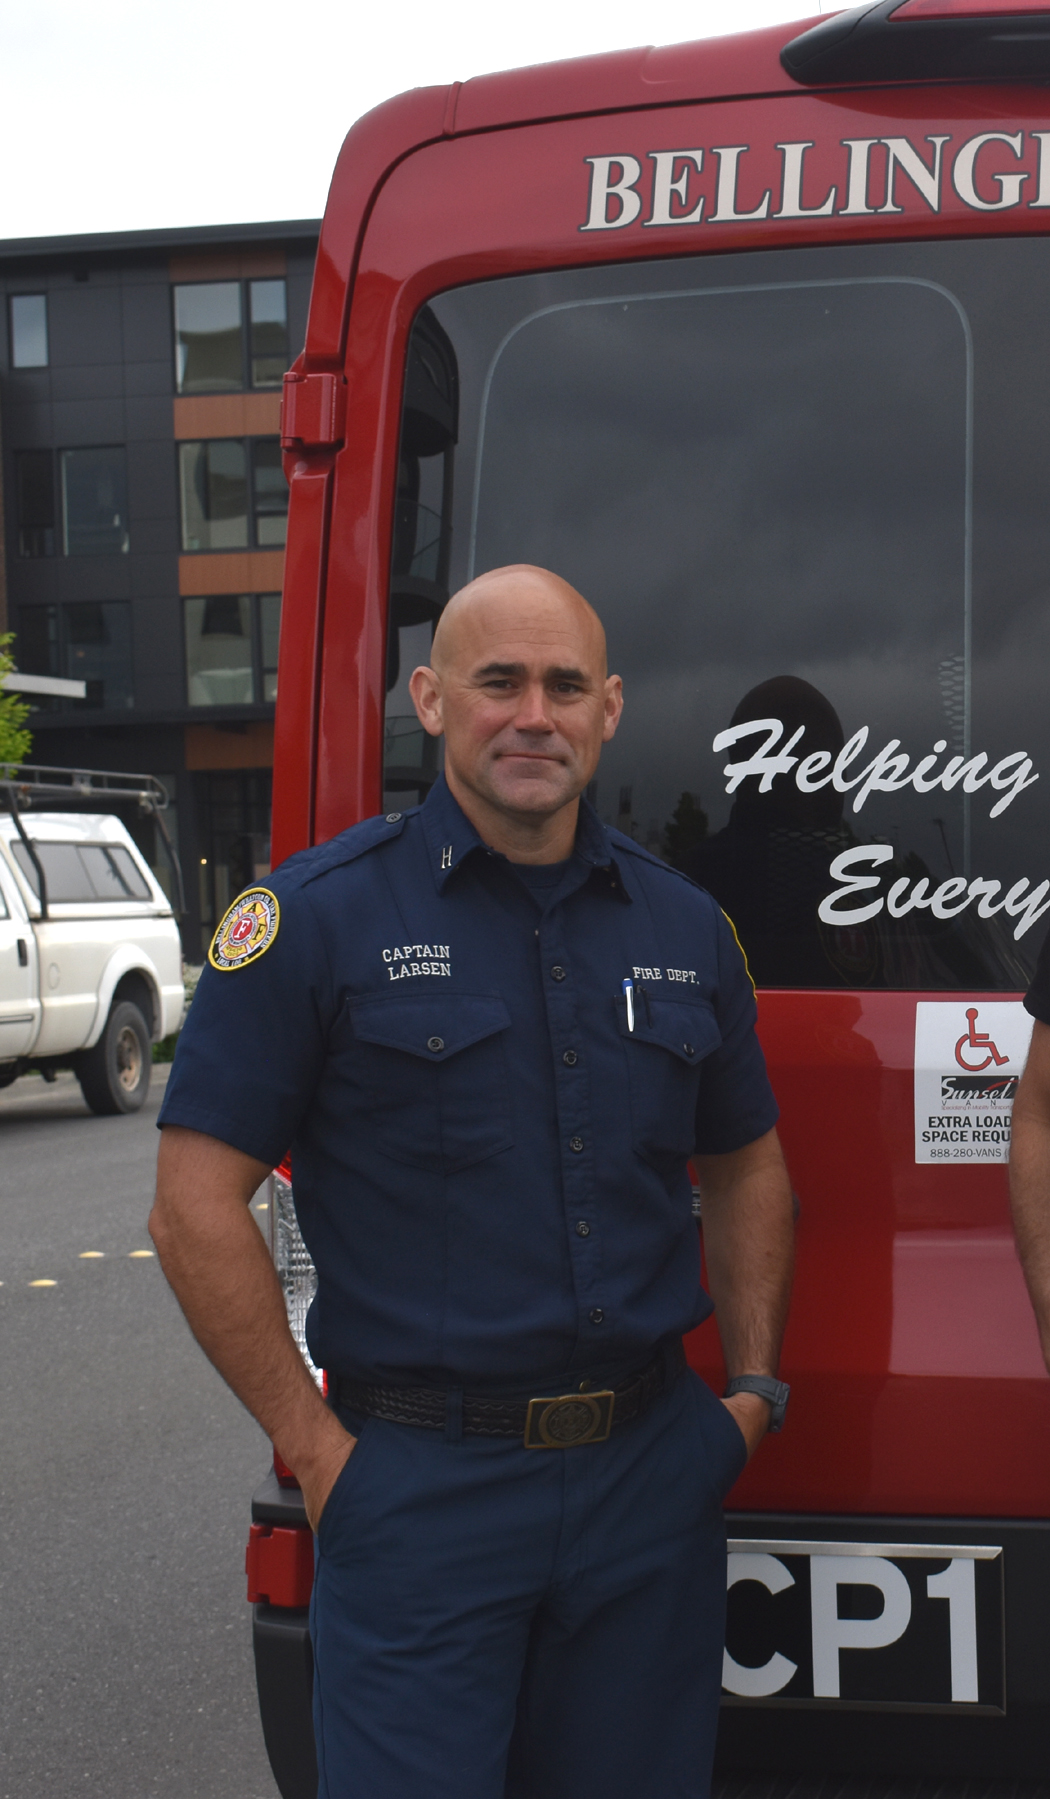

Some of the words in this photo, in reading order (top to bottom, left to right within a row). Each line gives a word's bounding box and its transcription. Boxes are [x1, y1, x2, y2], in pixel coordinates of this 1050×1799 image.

[713, 718, 1039, 818] Helping
[382, 944, 450, 962] CAPTAIN
[388, 962, 451, 981] LARSEN
[632, 966, 663, 980] FIRE
[665, 968, 700, 985] DEPT.
[928, 1116, 972, 1128] EXTRA
[922, 1130, 968, 1142] SPACE
[930, 1148, 1002, 1158] 888-280-VANS
[721, 1551, 979, 1702] CP1
